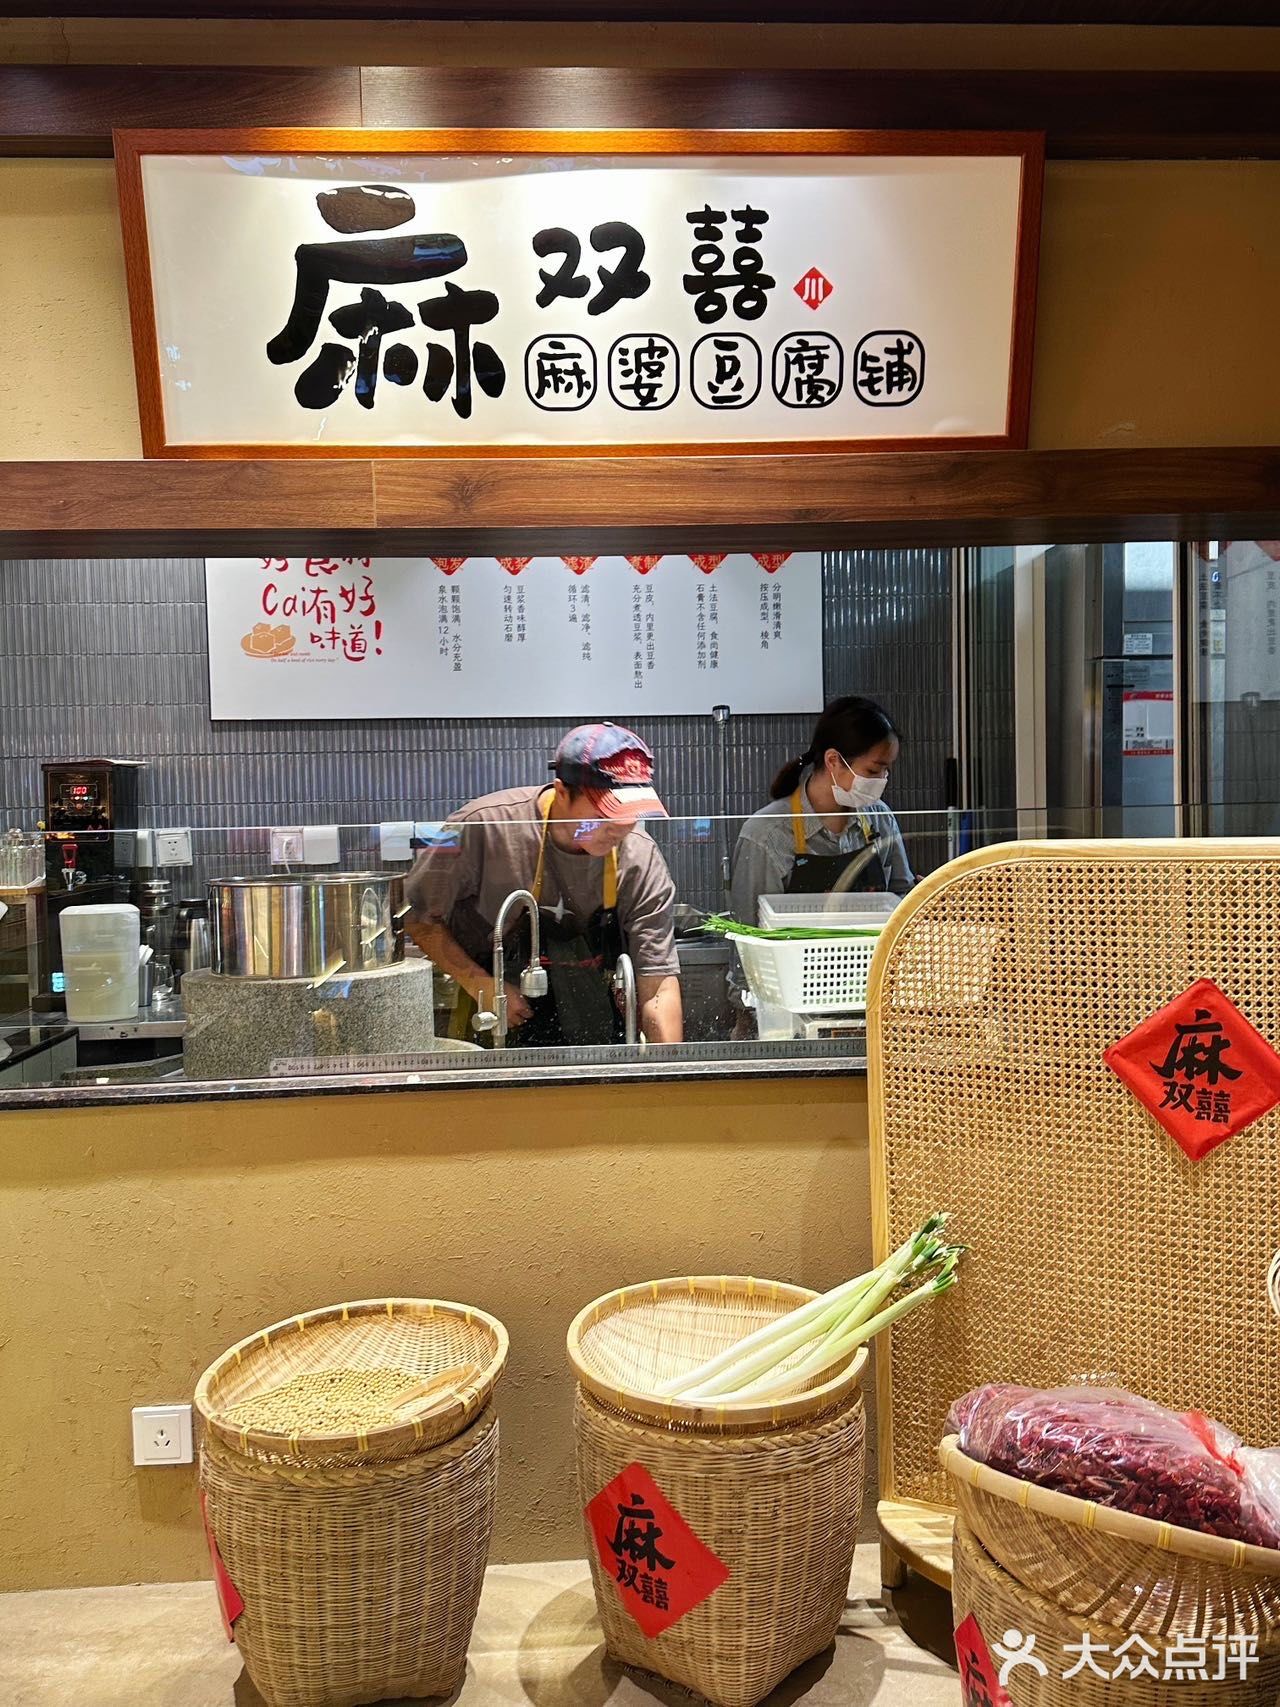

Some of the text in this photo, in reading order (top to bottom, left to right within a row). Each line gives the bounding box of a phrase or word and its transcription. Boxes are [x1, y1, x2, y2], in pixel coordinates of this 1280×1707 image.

[803, 276, 824, 303] 川
[533, 336, 918, 408] 麻婆豆腐铺
[438, 584, 450, 656] 泉水泡满12小时
[503, 584, 514, 642] 匀速转动石磨
[516, 584, 527, 642] 豆浆香味醇厚
[567, 584, 578, 623] 循环3遍
[696, 583, 707, 669] 石膏不含任何添加剂
[772, 582, 782, 640] 分明嫩滑清爽
[1148, 1008, 1244, 1086] 麻
[604, 1493, 677, 1572] 麻
